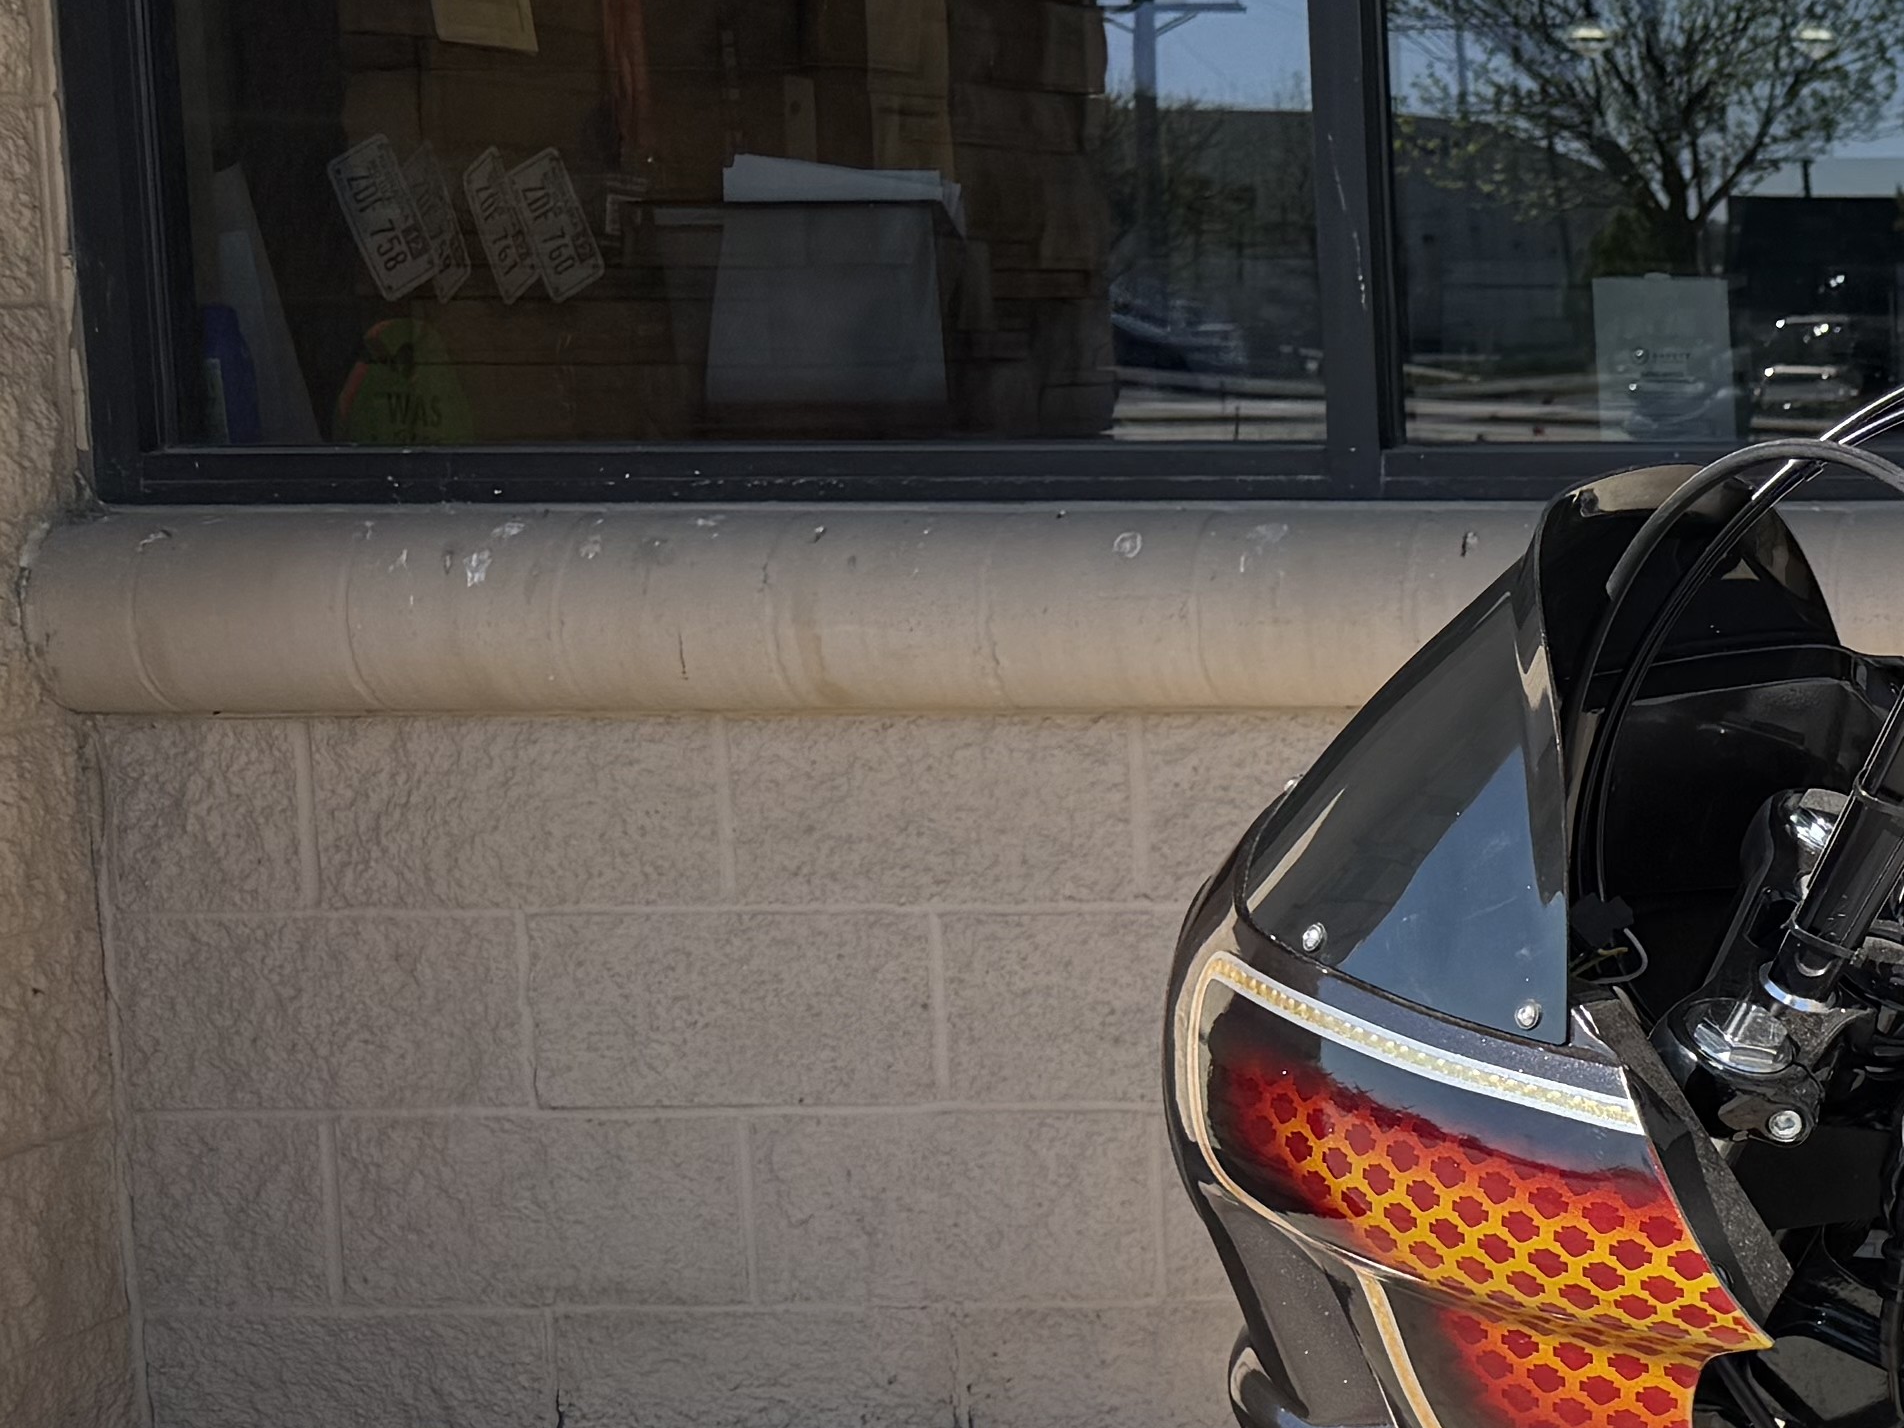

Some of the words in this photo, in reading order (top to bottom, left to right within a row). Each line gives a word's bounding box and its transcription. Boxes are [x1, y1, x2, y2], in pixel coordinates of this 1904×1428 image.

[369, 218, 407, 273] 758
[540, 230, 577, 278] 760
[385, 392, 444, 429] WAS
